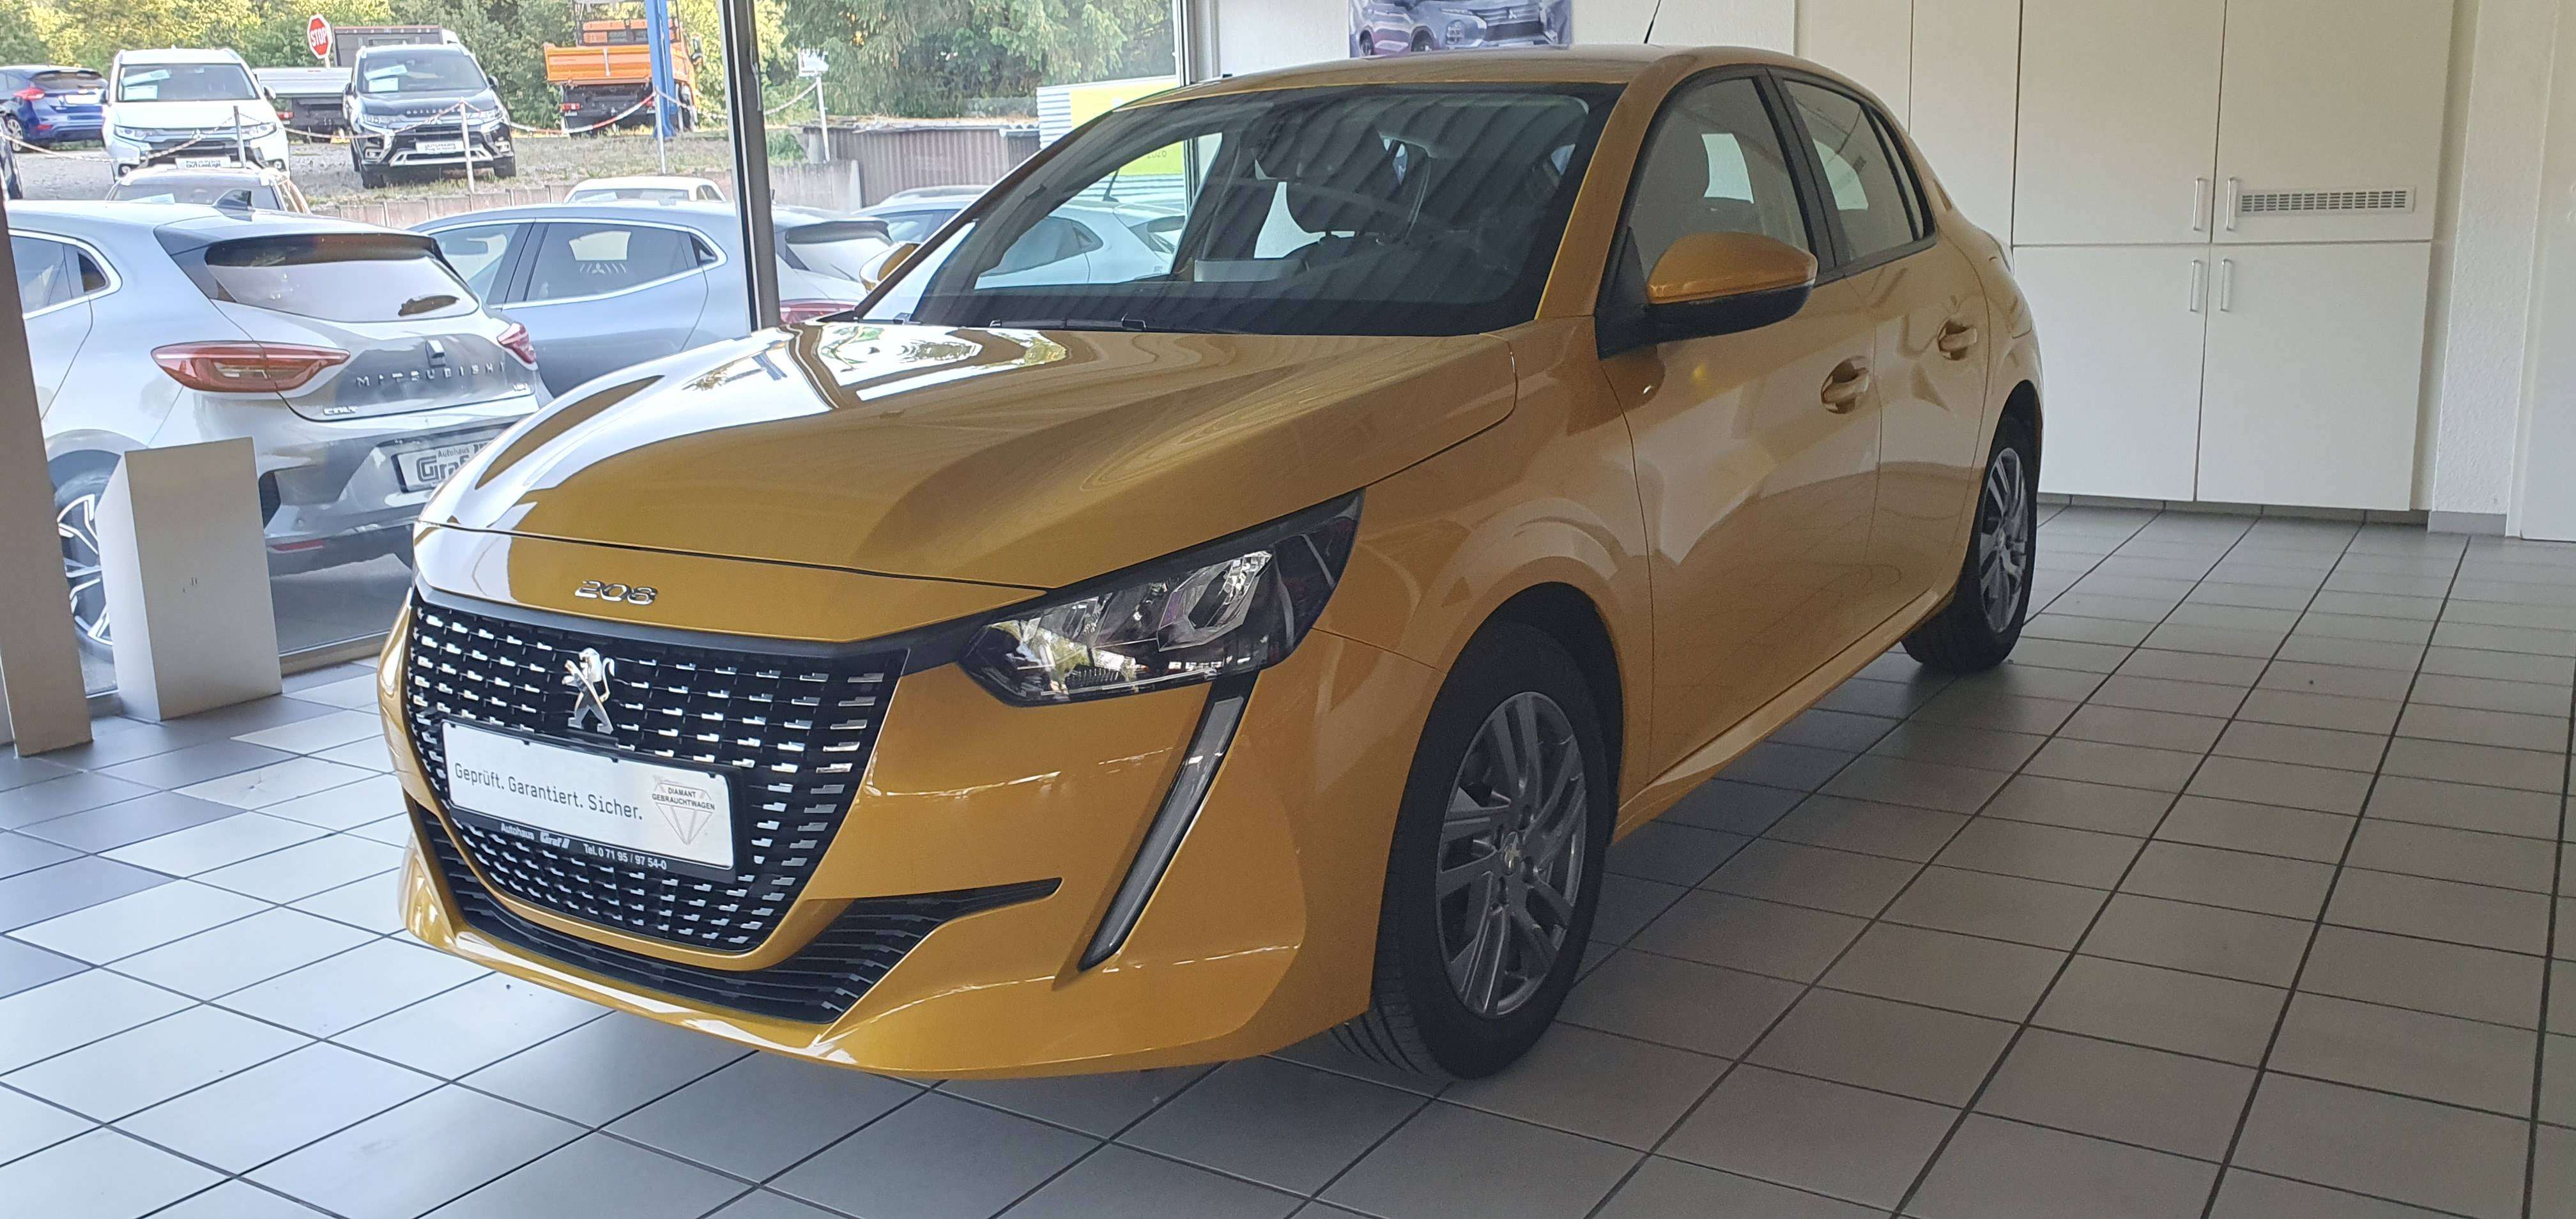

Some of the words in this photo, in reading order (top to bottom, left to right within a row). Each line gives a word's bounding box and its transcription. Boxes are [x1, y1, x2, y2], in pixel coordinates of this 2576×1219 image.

[310, 26, 327, 47] STOP
[356, 362, 505, 387] MITSUBISHI
[438, 447, 470, 459] Autohaus
[574, 579, 658, 605] 208
[454, 762, 505, 790] Geprüft.
[508, 776, 583, 808] Garantiert.
[588, 793, 643, 820] Sicher.
[652, 793, 716, 810] GEBRAUCHTWAGEN
[668, 787, 696, 798] DIAMANT
[501, 822, 535, 841] Autohaus
[583, 843, 597, 856] Tel.
[598, 847, 604, 857] 0
[605, 848, 615, 860] 71
[617, 851, 629, 863] 95
[635, 855, 646, 866] 97
[647, 857, 667, 870] 54-0
